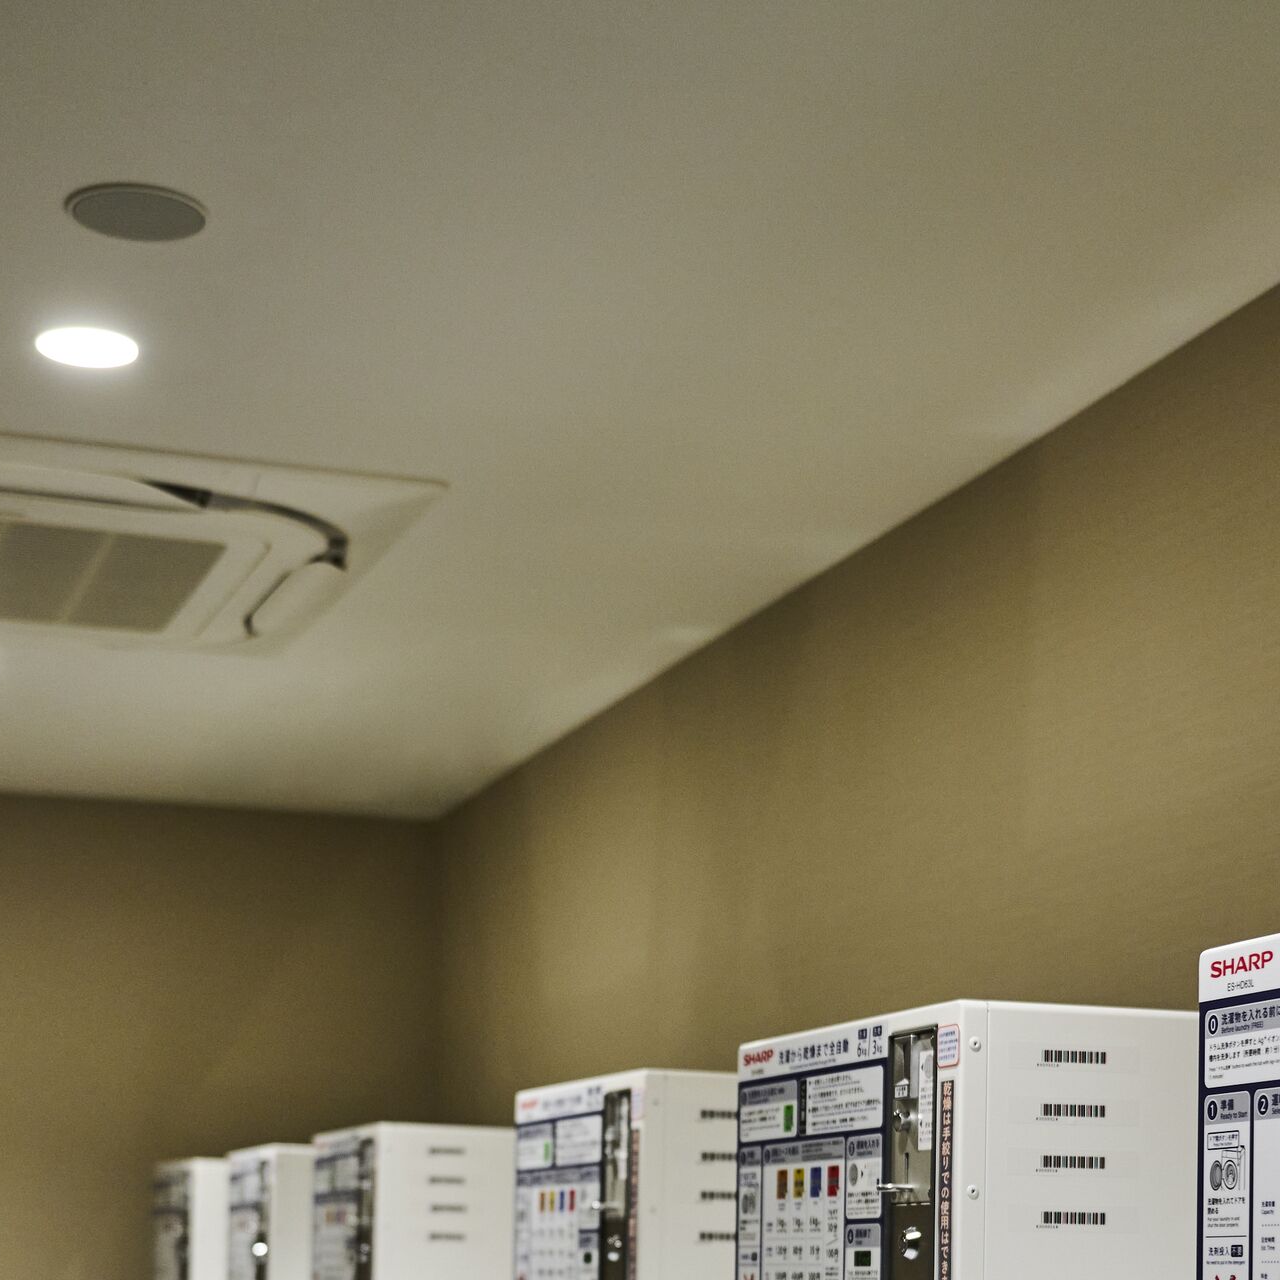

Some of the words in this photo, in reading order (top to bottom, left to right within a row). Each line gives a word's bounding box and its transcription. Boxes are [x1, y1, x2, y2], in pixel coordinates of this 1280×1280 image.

[1210, 950, 1273, 979] SHARP
[1221, 1025, 1235, 1034] Before
[1235, 1023, 1250, 1032] laundry
[743, 1049, 775, 1067] SHARP
[1220, 1111, 1232, 1120] Ready
[1237, 1109, 1248, 1118] Start
